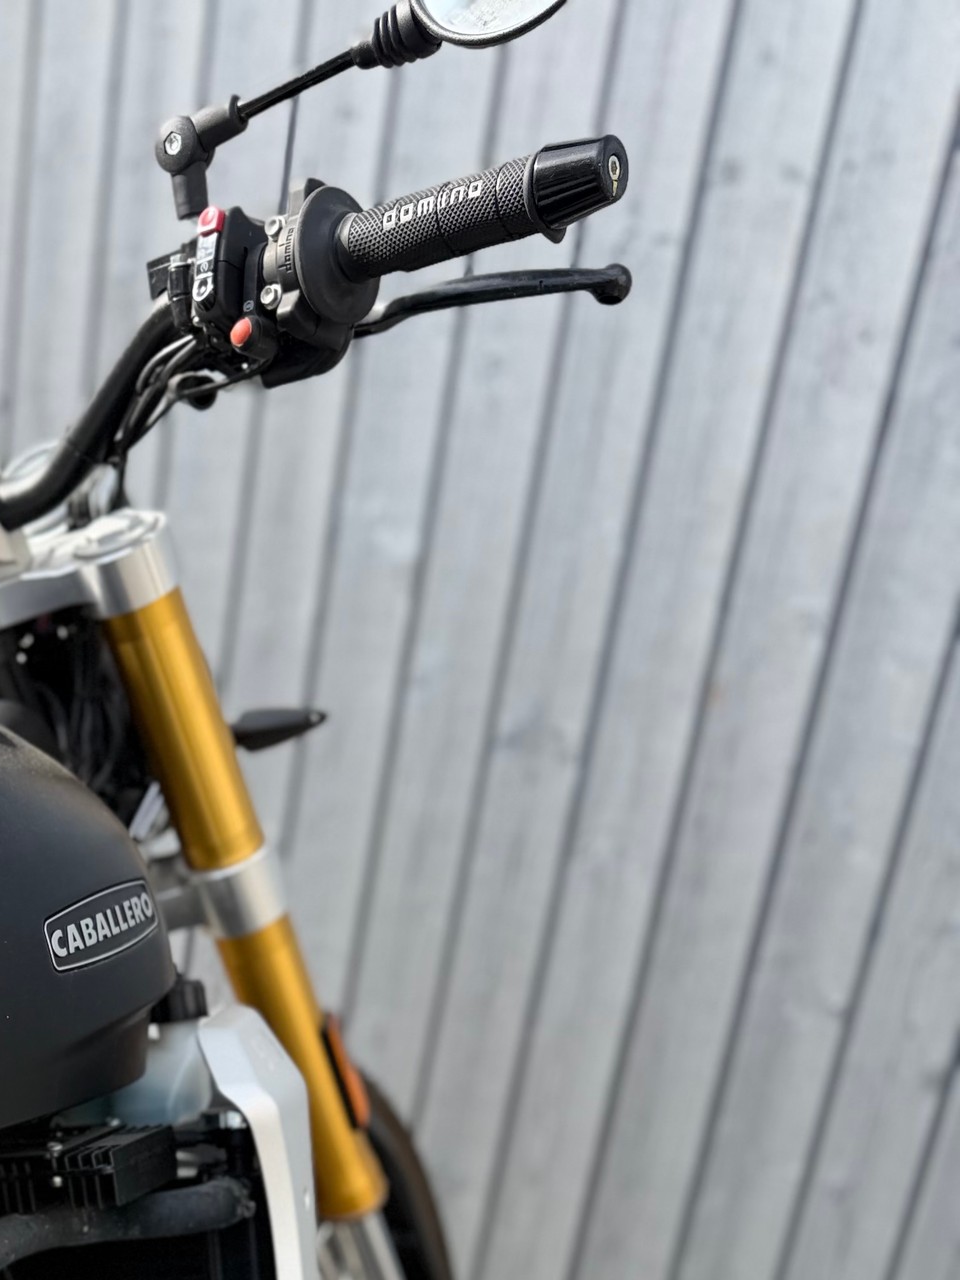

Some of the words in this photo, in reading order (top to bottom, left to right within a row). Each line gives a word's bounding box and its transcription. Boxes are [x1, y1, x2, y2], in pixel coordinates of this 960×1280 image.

[382, 179, 483, 231] domino
[278, 227, 295, 273] domino
[51, 891, 152, 957] CABALLERO
